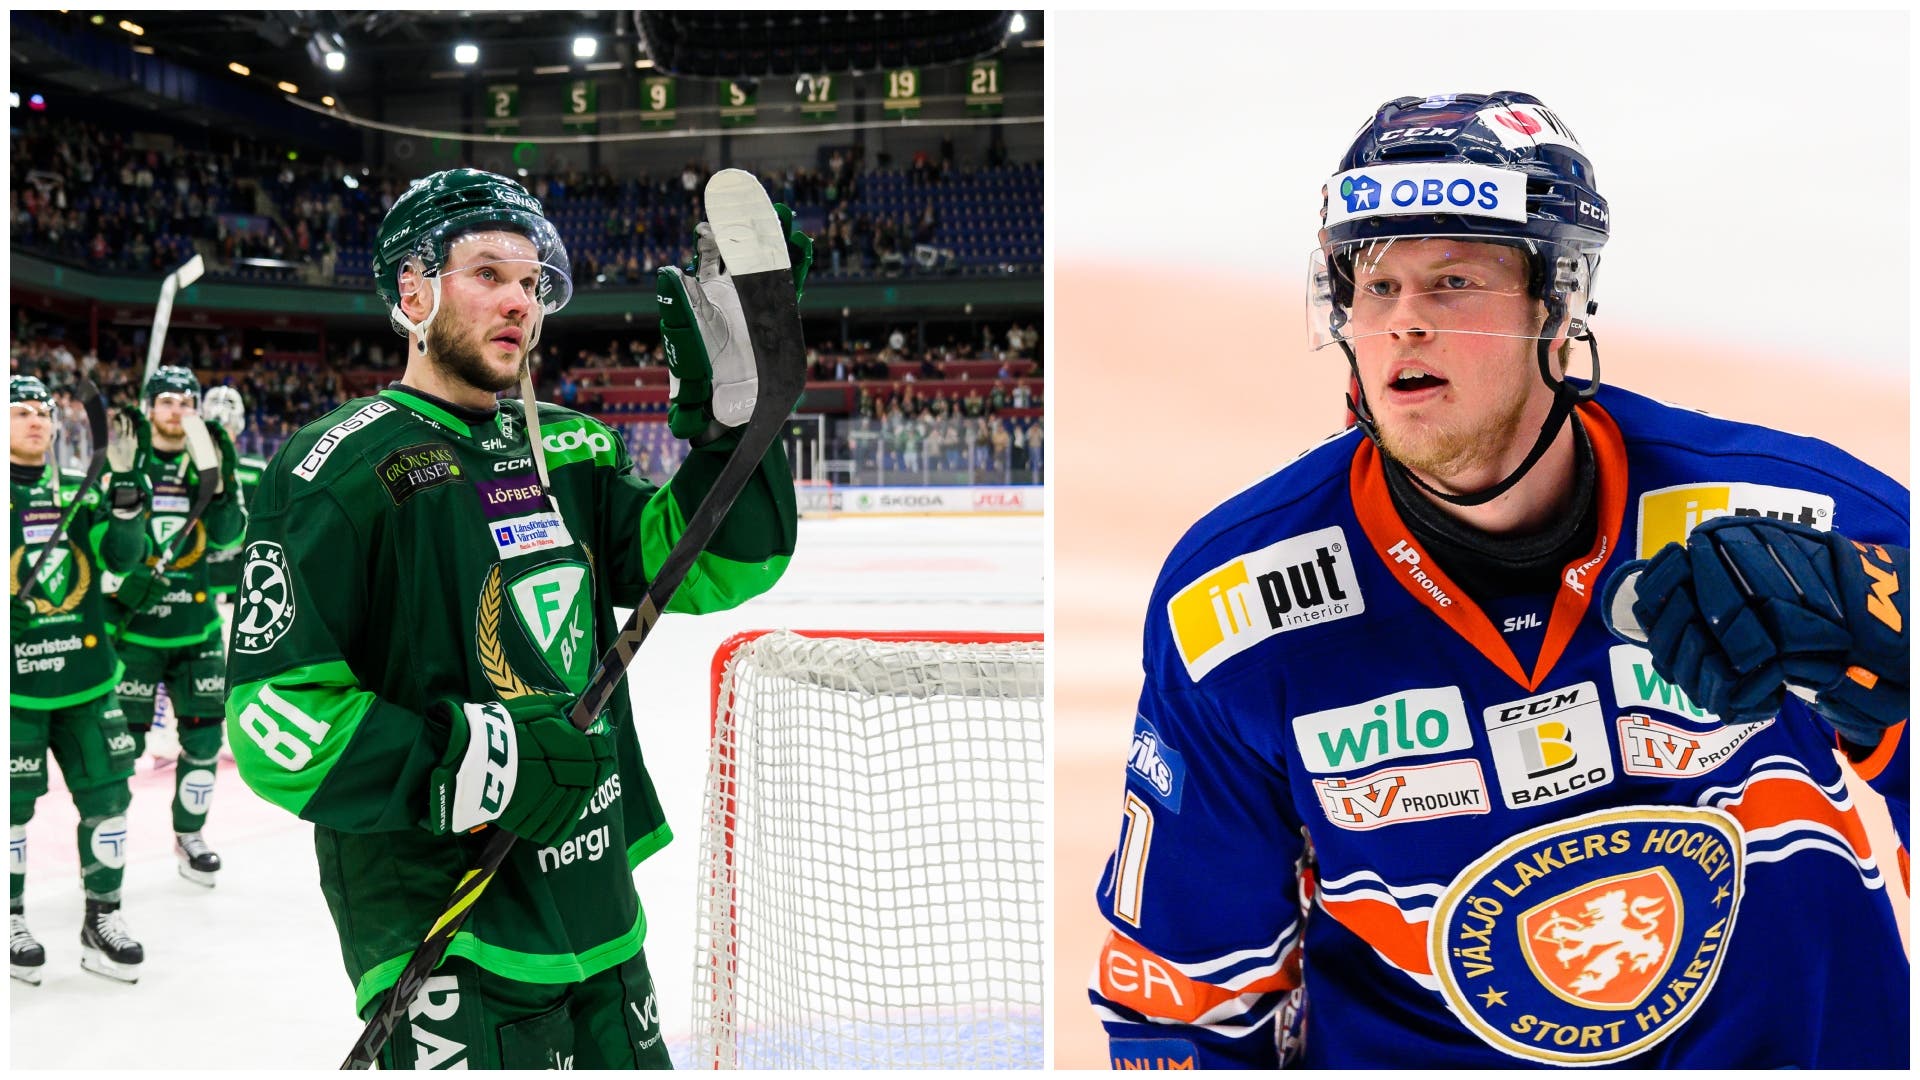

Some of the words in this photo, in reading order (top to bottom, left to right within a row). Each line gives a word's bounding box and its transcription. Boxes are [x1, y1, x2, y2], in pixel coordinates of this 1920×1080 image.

[889, 70, 916, 98] 19
[971, 68, 998, 94] 21
[494, 92, 511, 118] 2
[571, 87, 588, 114] 5
[649, 84, 667, 110] 9
[1379, 126, 1458, 142] CCM
[1390, 178, 1499, 210] OBOS
[1579, 199, 1609, 225] CCM
[383, 227, 412, 249] CCM
[481, 437, 507, 451] SHL
[542, 428, 611, 457] coop
[386, 448, 454, 482] GRÖNSAKS
[407, 462, 451, 487] HUSET
[493, 457, 532, 473] CCM
[977, 494, 1021, 507] JULA
[1208, 546, 1348, 642] input
[532, 581, 561, 642] F
[1286, 602, 1351, 627] interiör
[1503, 612, 1543, 634] SHL
[560, 605, 585, 675] BK
[1499, 689, 1580, 723] CCM
[238, 683, 332, 773] 81
[1318, 698, 1449, 768] wilo
[1511, 767, 1607, 805] BALCO
[1402, 789, 1481, 813] PRODUKT
[1113, 790, 1155, 929] 1
[1453, 895, 1504, 979] VÄXJÖ
[1492, 829, 1631, 898] LAKERS
[1641, 828, 1731, 882] HOCKEY
[1510, 1013, 1627, 1048] STORT
[1635, 917, 1727, 1033] HJÄRTA
